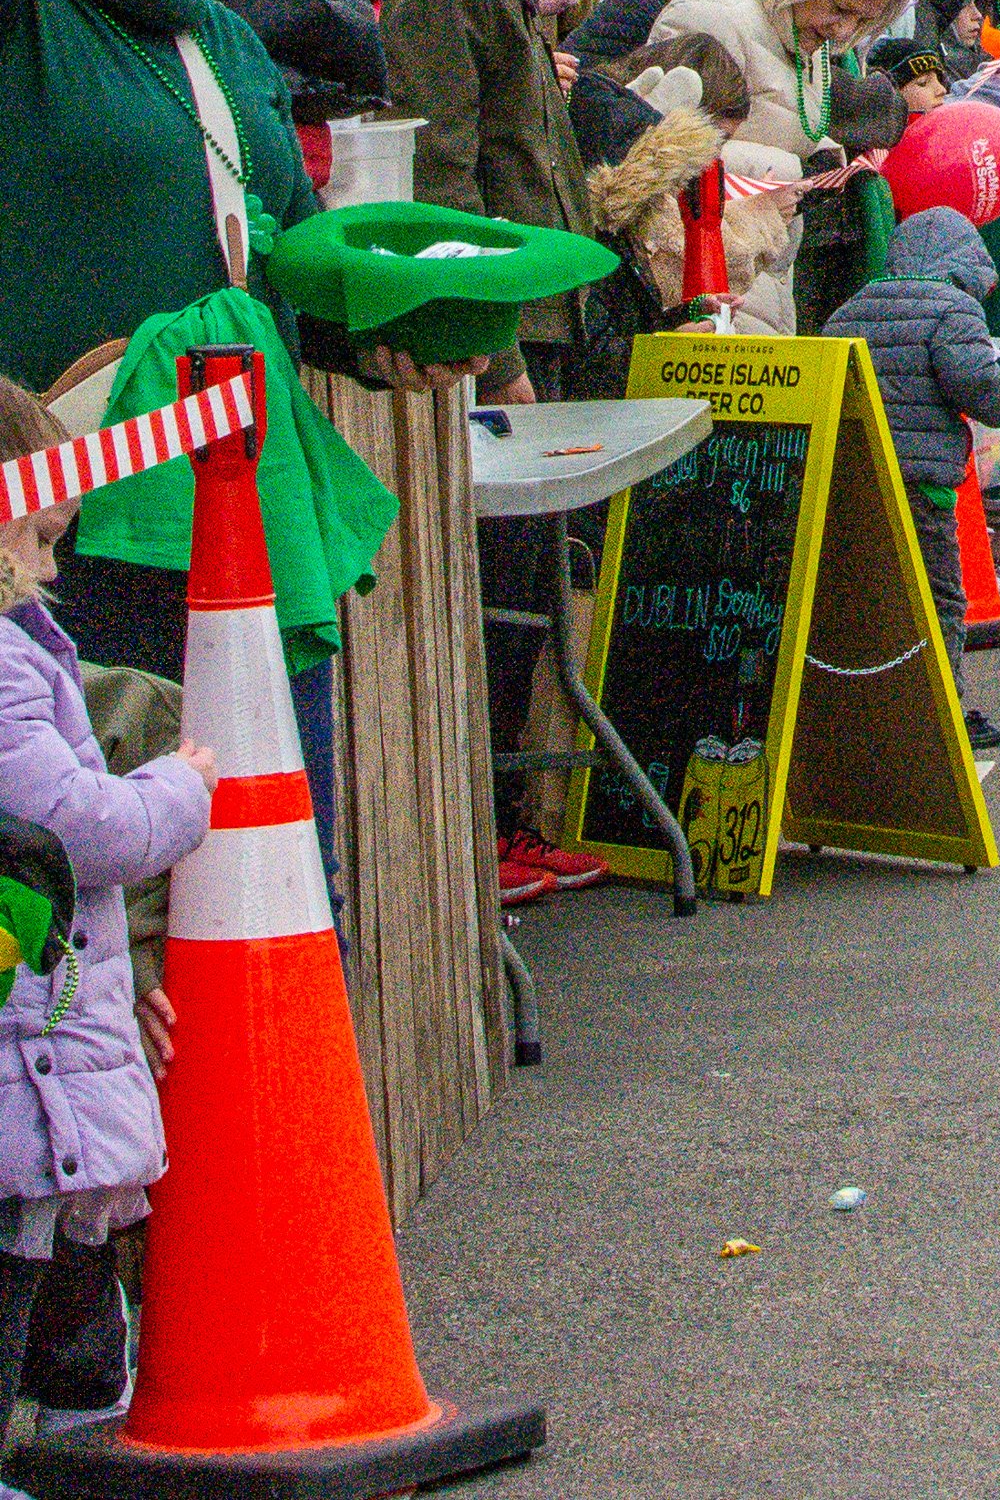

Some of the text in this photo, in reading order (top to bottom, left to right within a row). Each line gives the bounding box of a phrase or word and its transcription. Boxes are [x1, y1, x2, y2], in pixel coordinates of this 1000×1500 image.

[692, 344, 774, 355] BORN IN CHICAGO
[661, 361, 801, 387] GOOSE ISLAND
[738, 393, 766, 415] CO.
[729, 478, 751, 514] $6
[622, 583, 711, 631] DUBLIN
[703, 623, 741, 664] $10
[720, 799, 761, 864] 312
